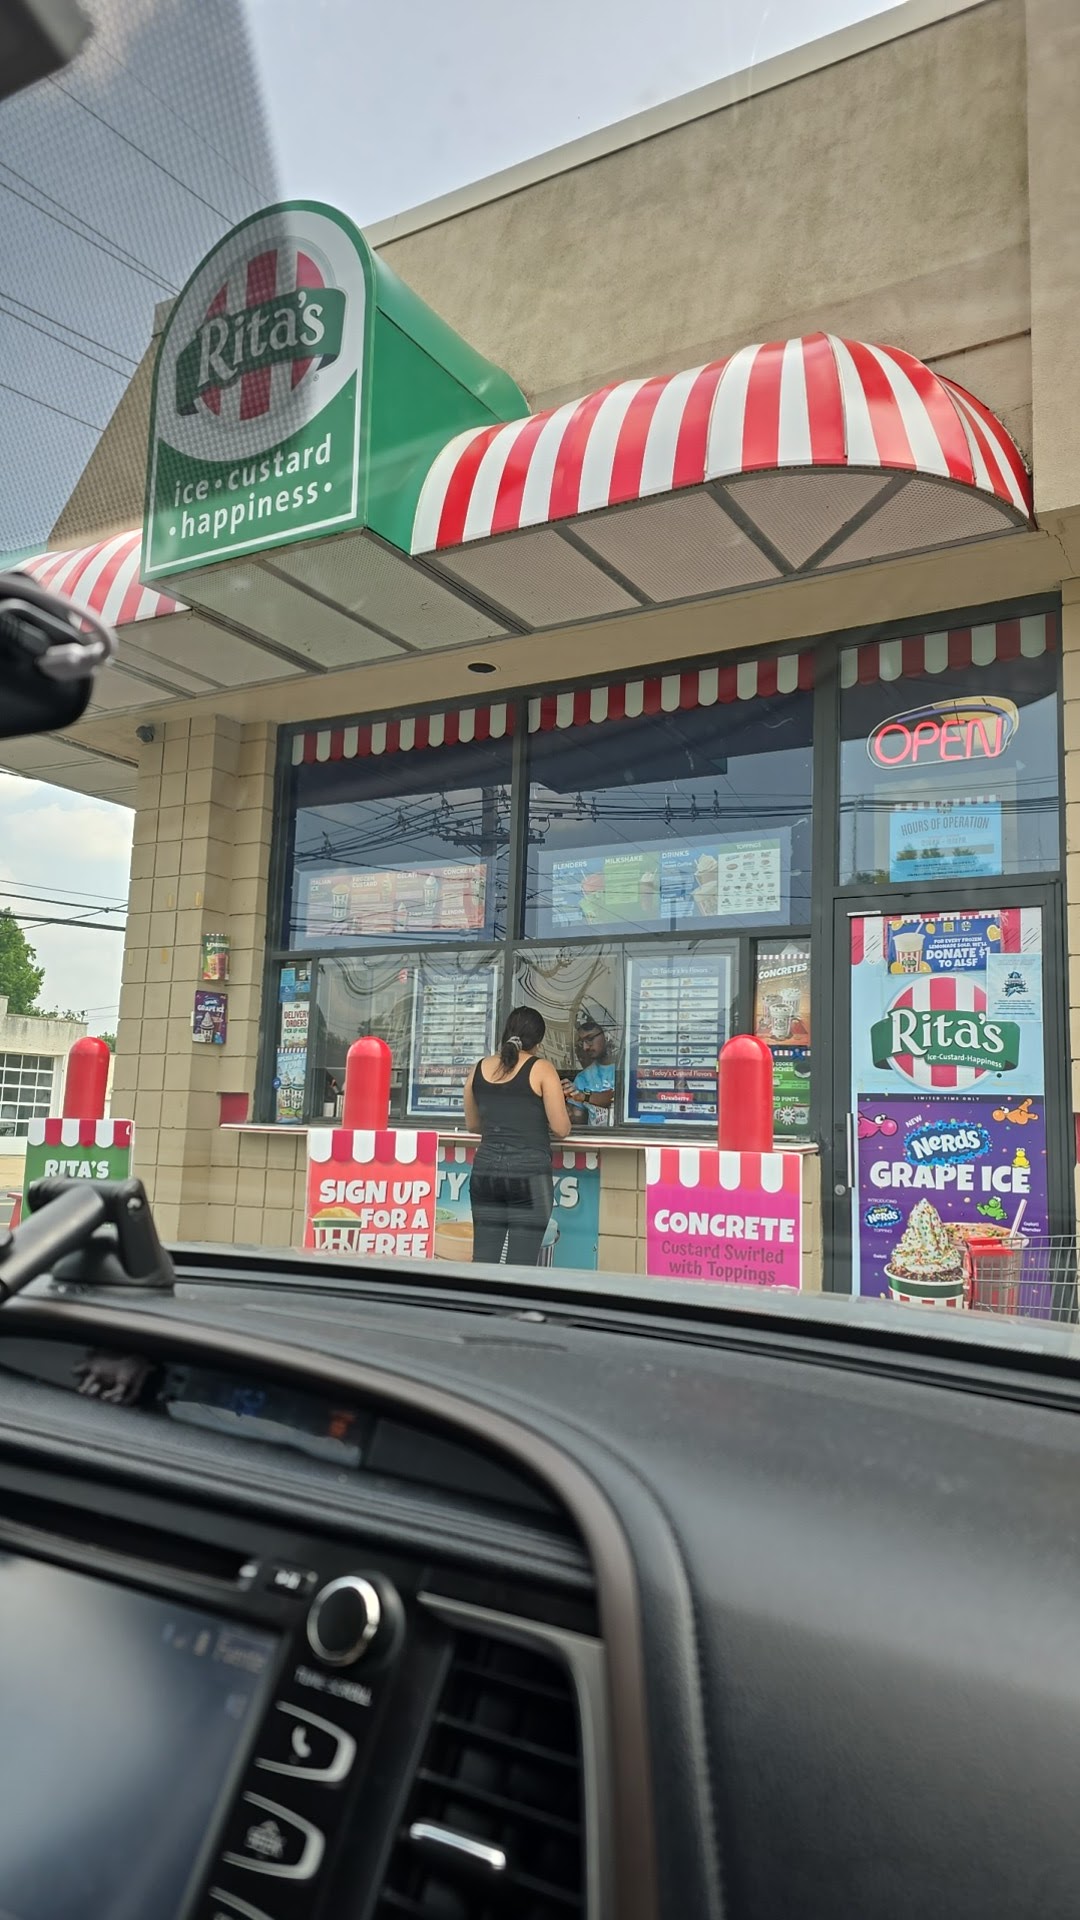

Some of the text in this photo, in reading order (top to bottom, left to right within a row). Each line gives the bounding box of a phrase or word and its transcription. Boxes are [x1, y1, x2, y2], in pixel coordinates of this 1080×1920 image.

[197, 291, 326, 386] Rita's
[173, 433, 331, 508] ice custard
[180, 483, 318, 540] happiness
[874, 716, 1003, 765] OPEN
[900, 816, 990, 837] HOURS OF OPERATION
[553, 860, 588, 870] BLENDERS
[604, 854, 644, 865] MILKSHAKE
[661, 849, 690, 859] DRINKS
[926, 948, 977, 960] DONATE
[938, 958, 979, 968] TO ALSF
[758, 962, 808, 979] CONCRETES
[890, 1008, 1004, 1054] Rita's
[652, 1070, 672, 1078] Today's
[905, 1114, 923, 1129] NEW
[44, 1159, 109, 1179] RITA'S
[869, 1160, 1031, 1194] GRAPE ICE
[318, 1179, 431, 1205] SIGN UP
[360, 1208, 429, 1229] FOR A
[654, 1209, 796, 1243] CONCRETE
[358, 1233, 429, 1258] FREE
[661, 1240, 784, 1264] Custard Swirled
[669, 1258, 776, 1285] with Toppings
